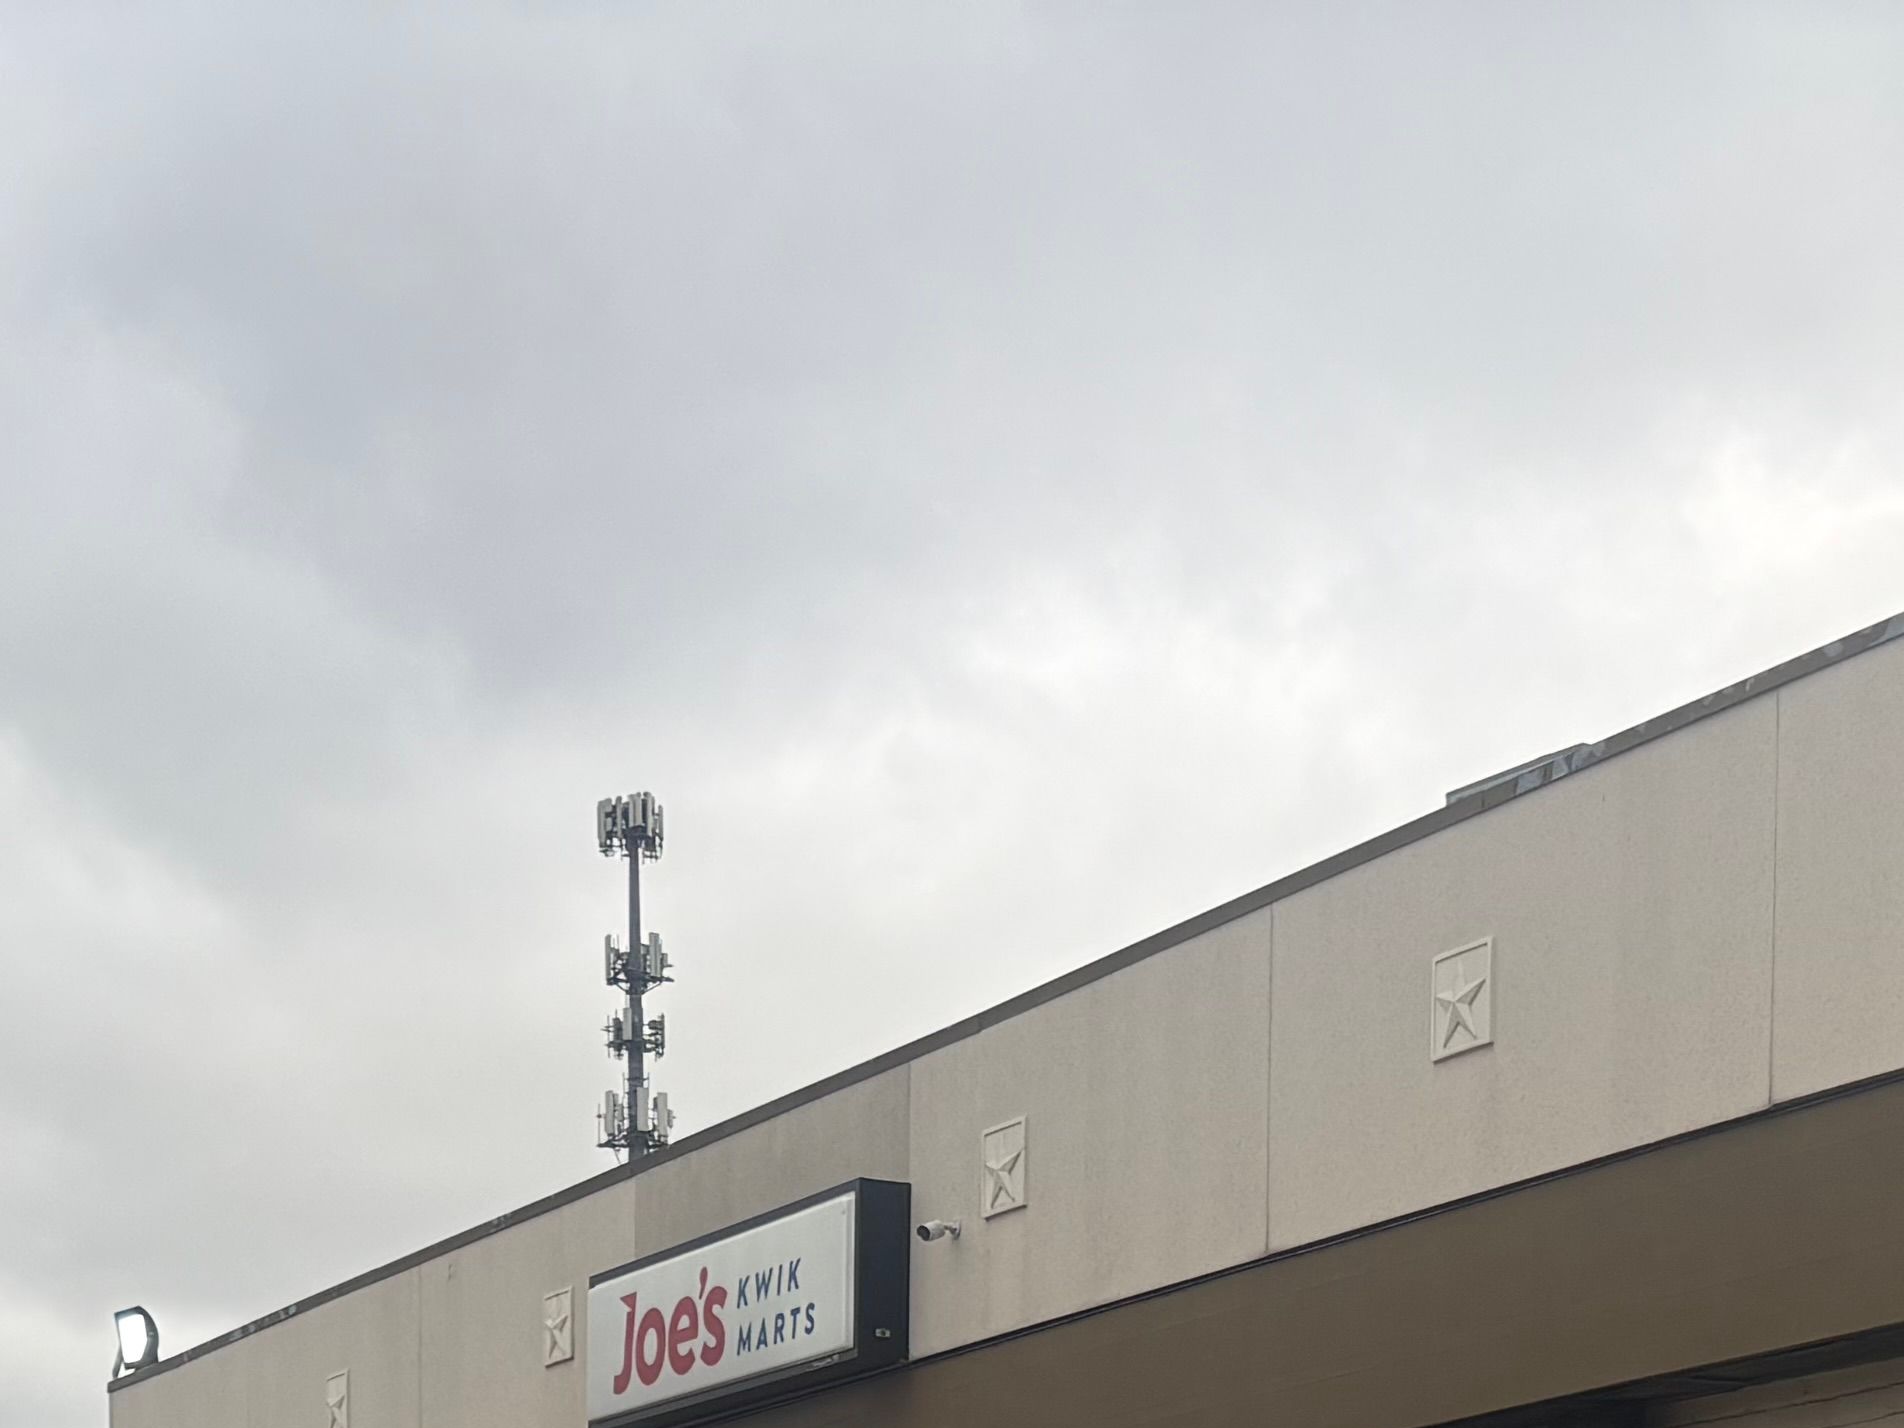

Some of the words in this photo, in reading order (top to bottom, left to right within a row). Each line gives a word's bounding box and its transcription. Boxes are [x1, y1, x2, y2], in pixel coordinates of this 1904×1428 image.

[737, 1257, 802, 1310] KWIK
[612, 1266, 728, 1396] Joe's
[736, 1302, 816, 1357] MARTS
